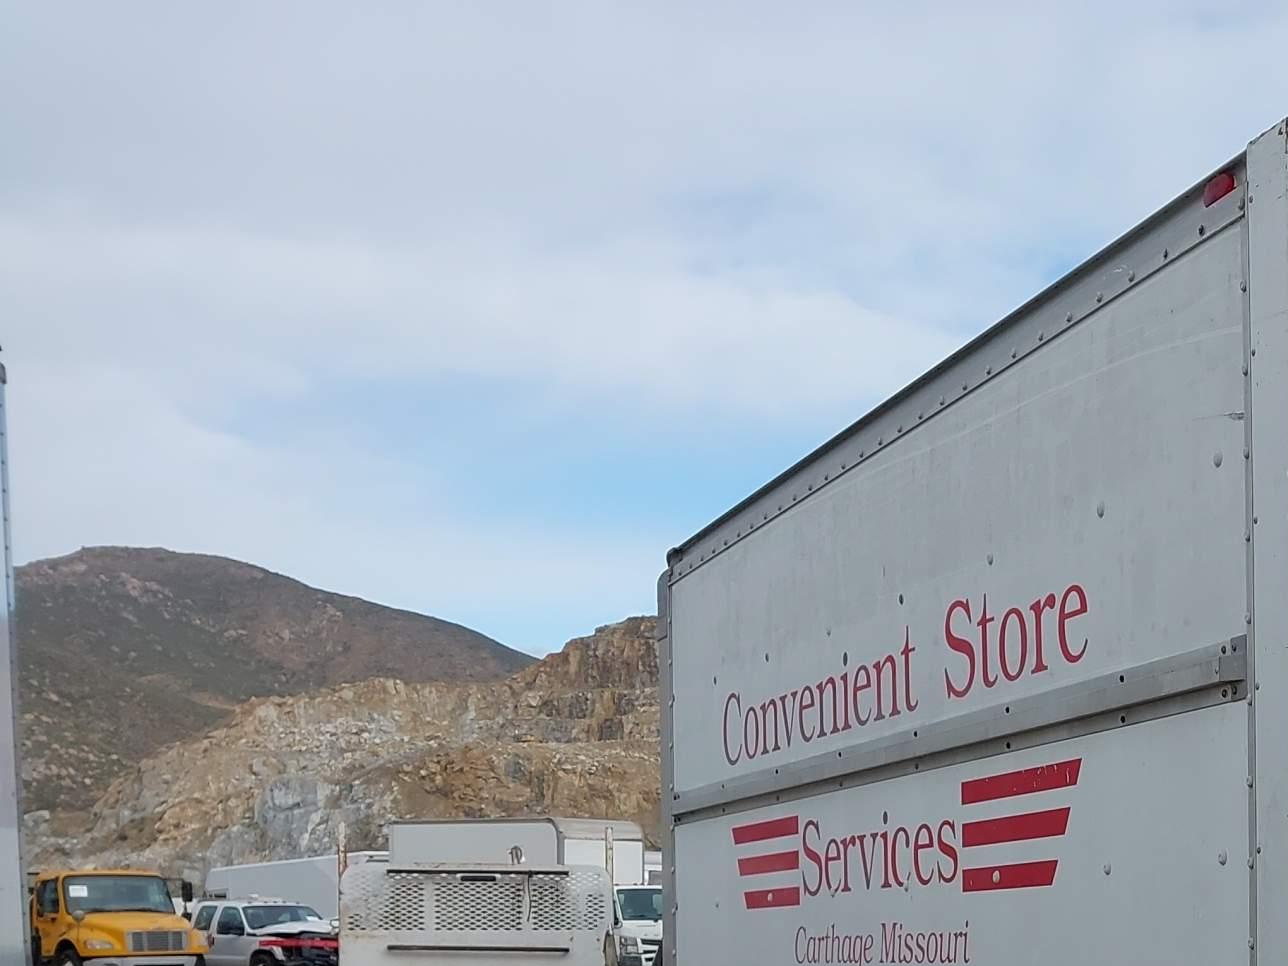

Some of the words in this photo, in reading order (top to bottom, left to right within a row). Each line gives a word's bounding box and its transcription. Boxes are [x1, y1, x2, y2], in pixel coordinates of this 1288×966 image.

[723, 625, 918, 766] Convenient
[944, 584, 1088, 699] Store
[801, 811, 958, 896] Services
[879, 919, 970, 964] Missouri
